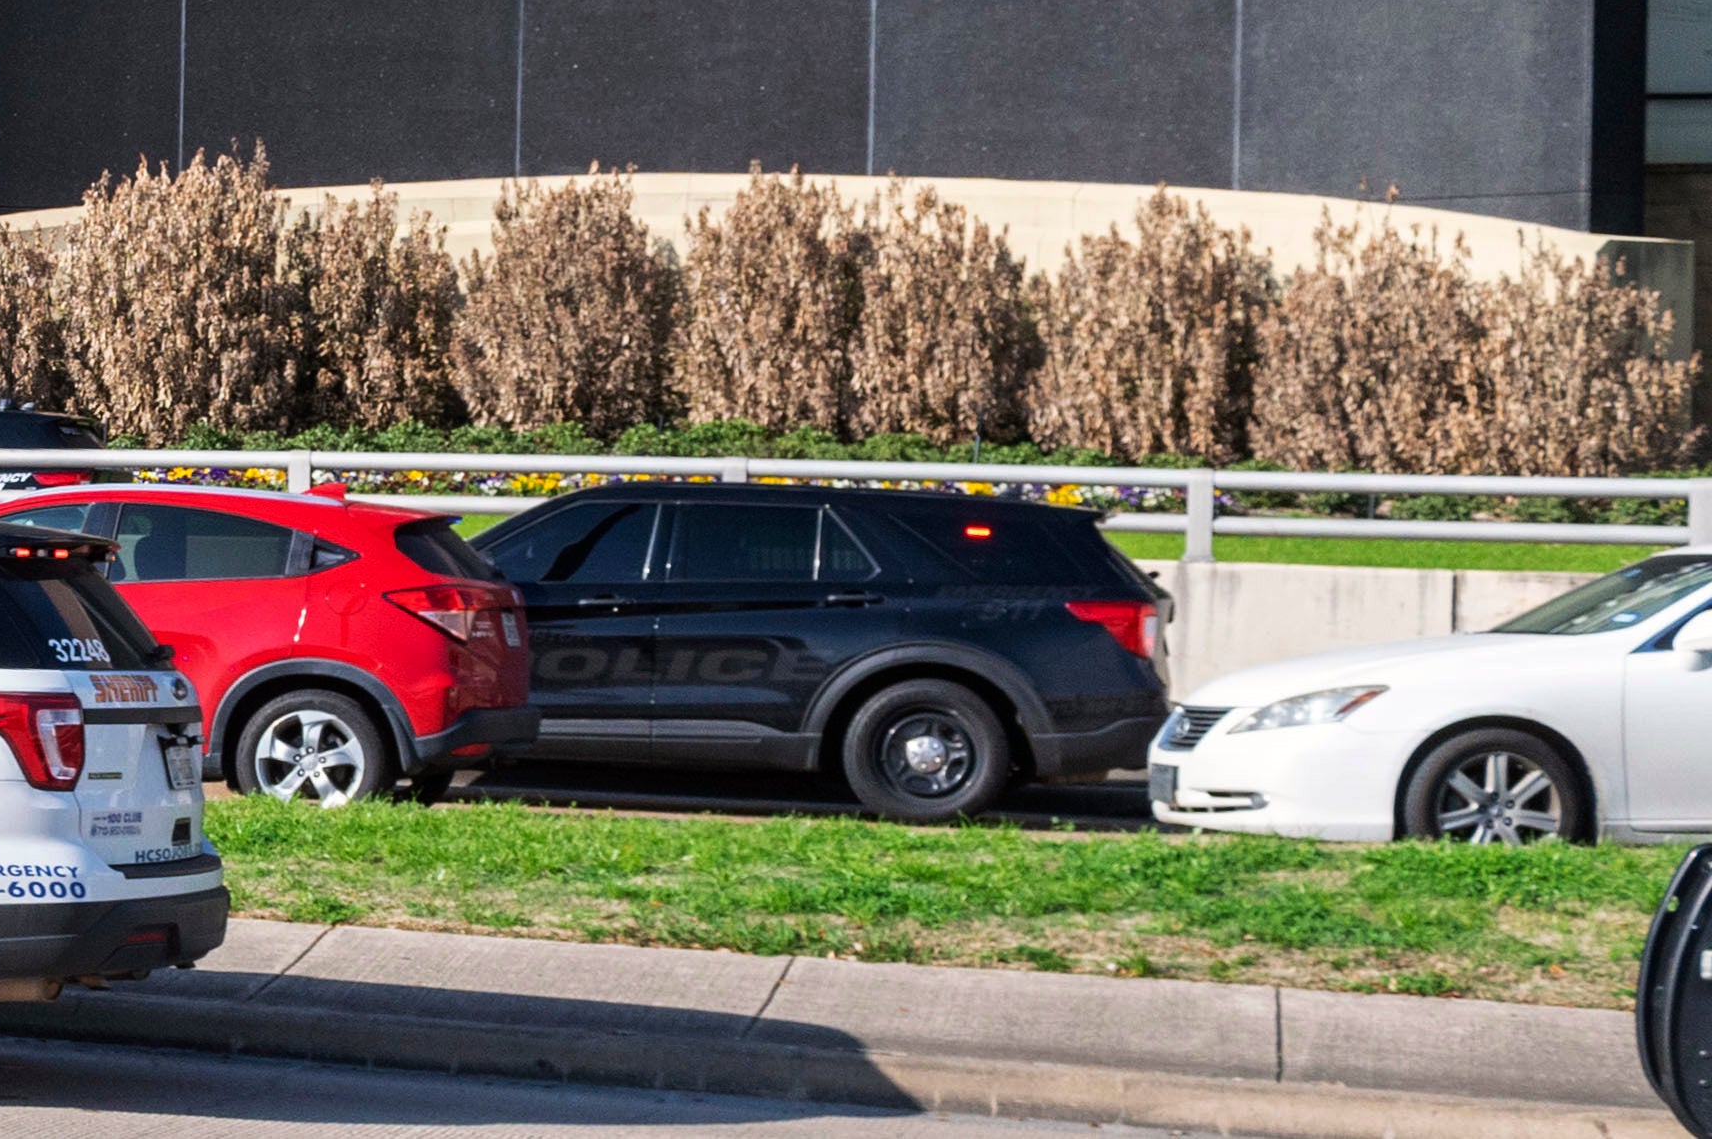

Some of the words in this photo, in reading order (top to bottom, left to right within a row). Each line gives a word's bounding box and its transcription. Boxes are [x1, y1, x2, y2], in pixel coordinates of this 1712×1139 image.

[50, 638, 110, 663] 32248
[534, 647, 831, 682] OLICE
[91, 674, 158, 703] SHERIFF
